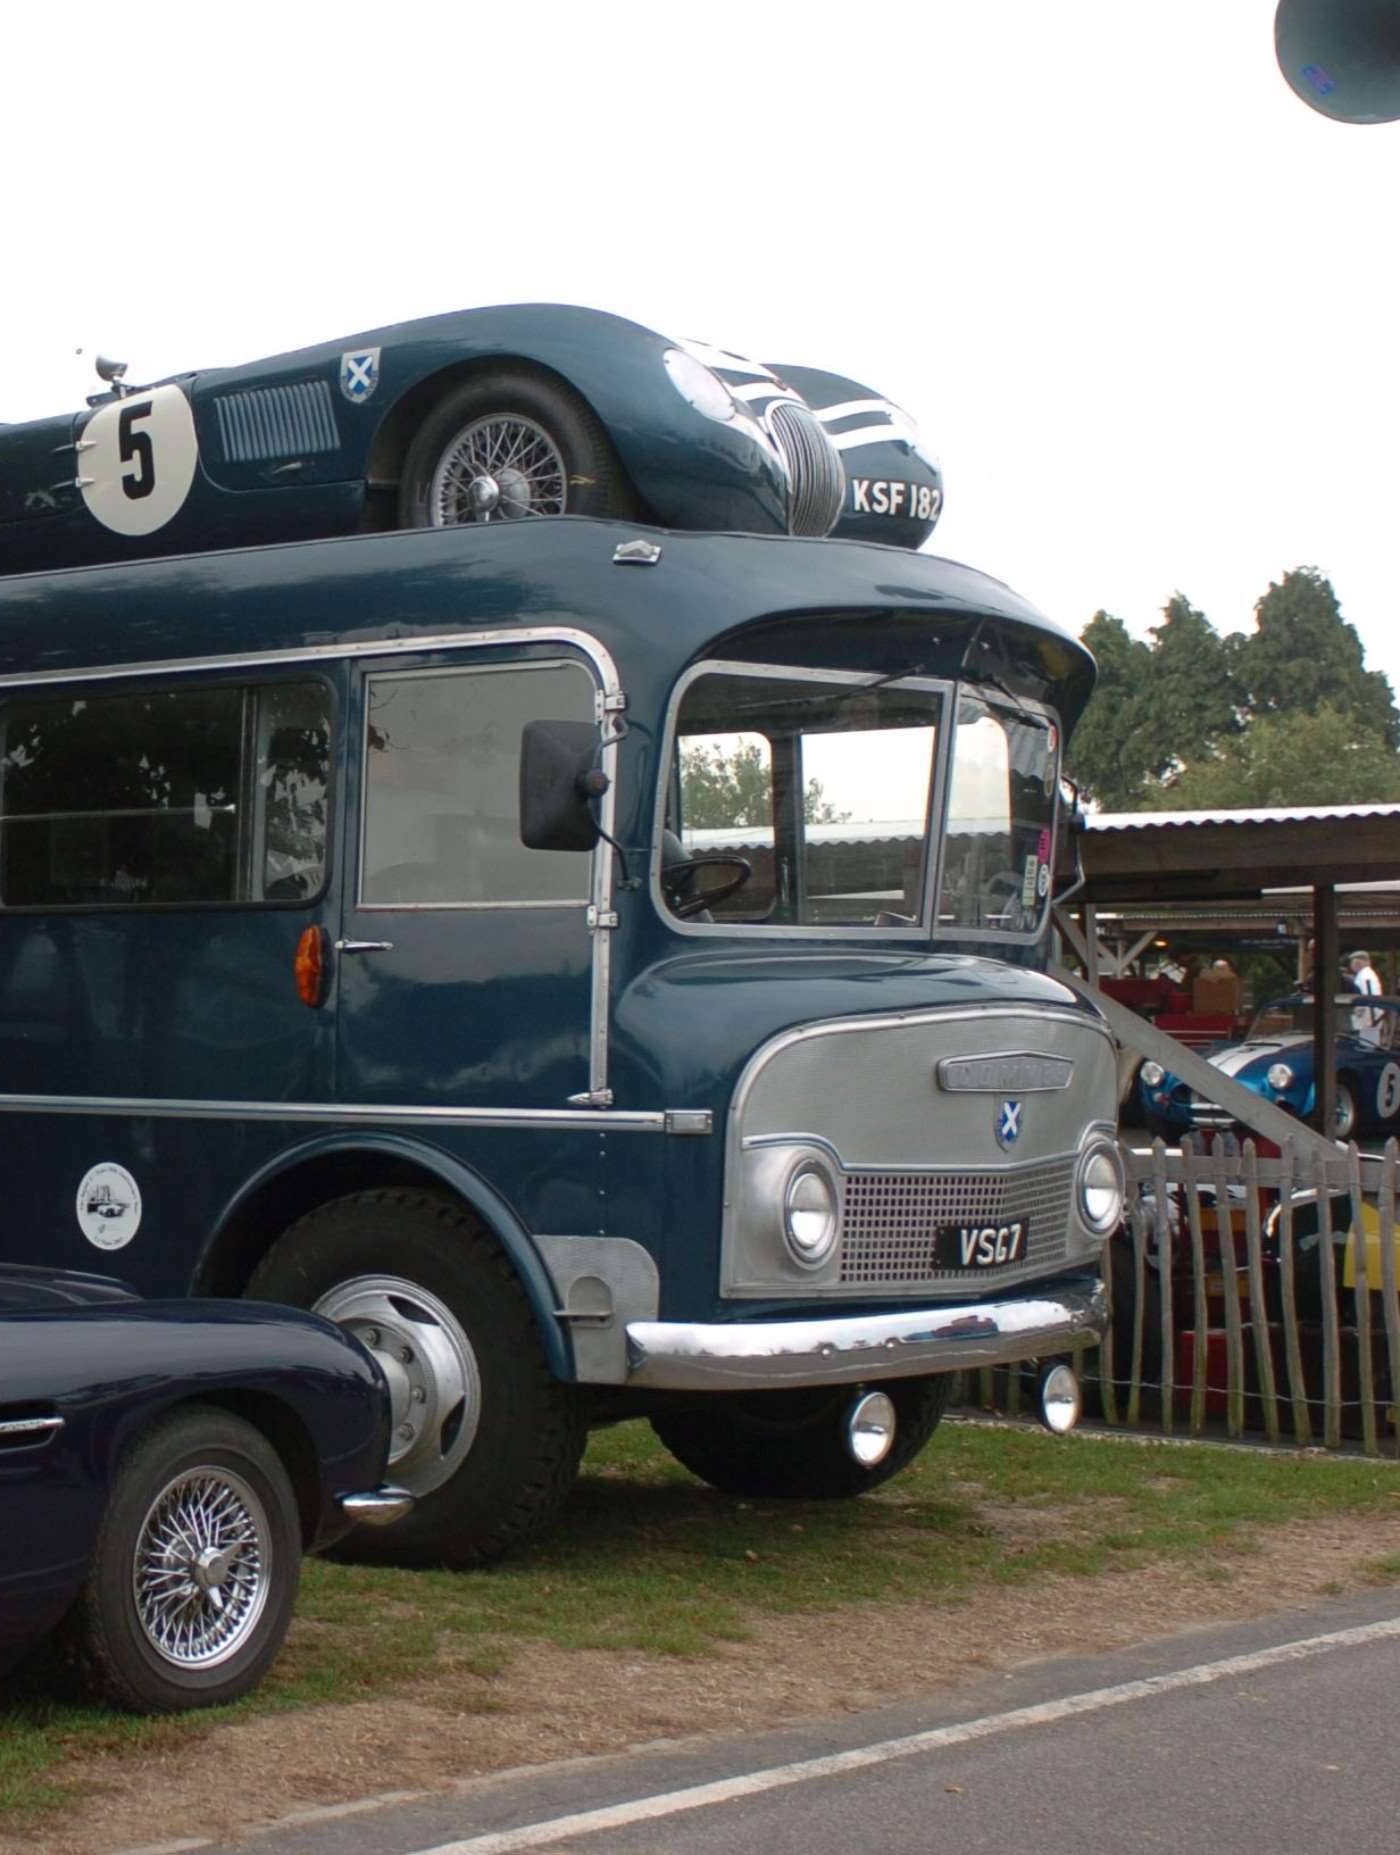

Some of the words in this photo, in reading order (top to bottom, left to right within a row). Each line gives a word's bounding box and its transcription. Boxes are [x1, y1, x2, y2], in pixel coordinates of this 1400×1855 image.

[118, 400, 155, 500] 5
[852, 479, 905, 515] KSF
[909, 484, 940, 521] 182
[961, 1223, 1021, 1266] VSG7
